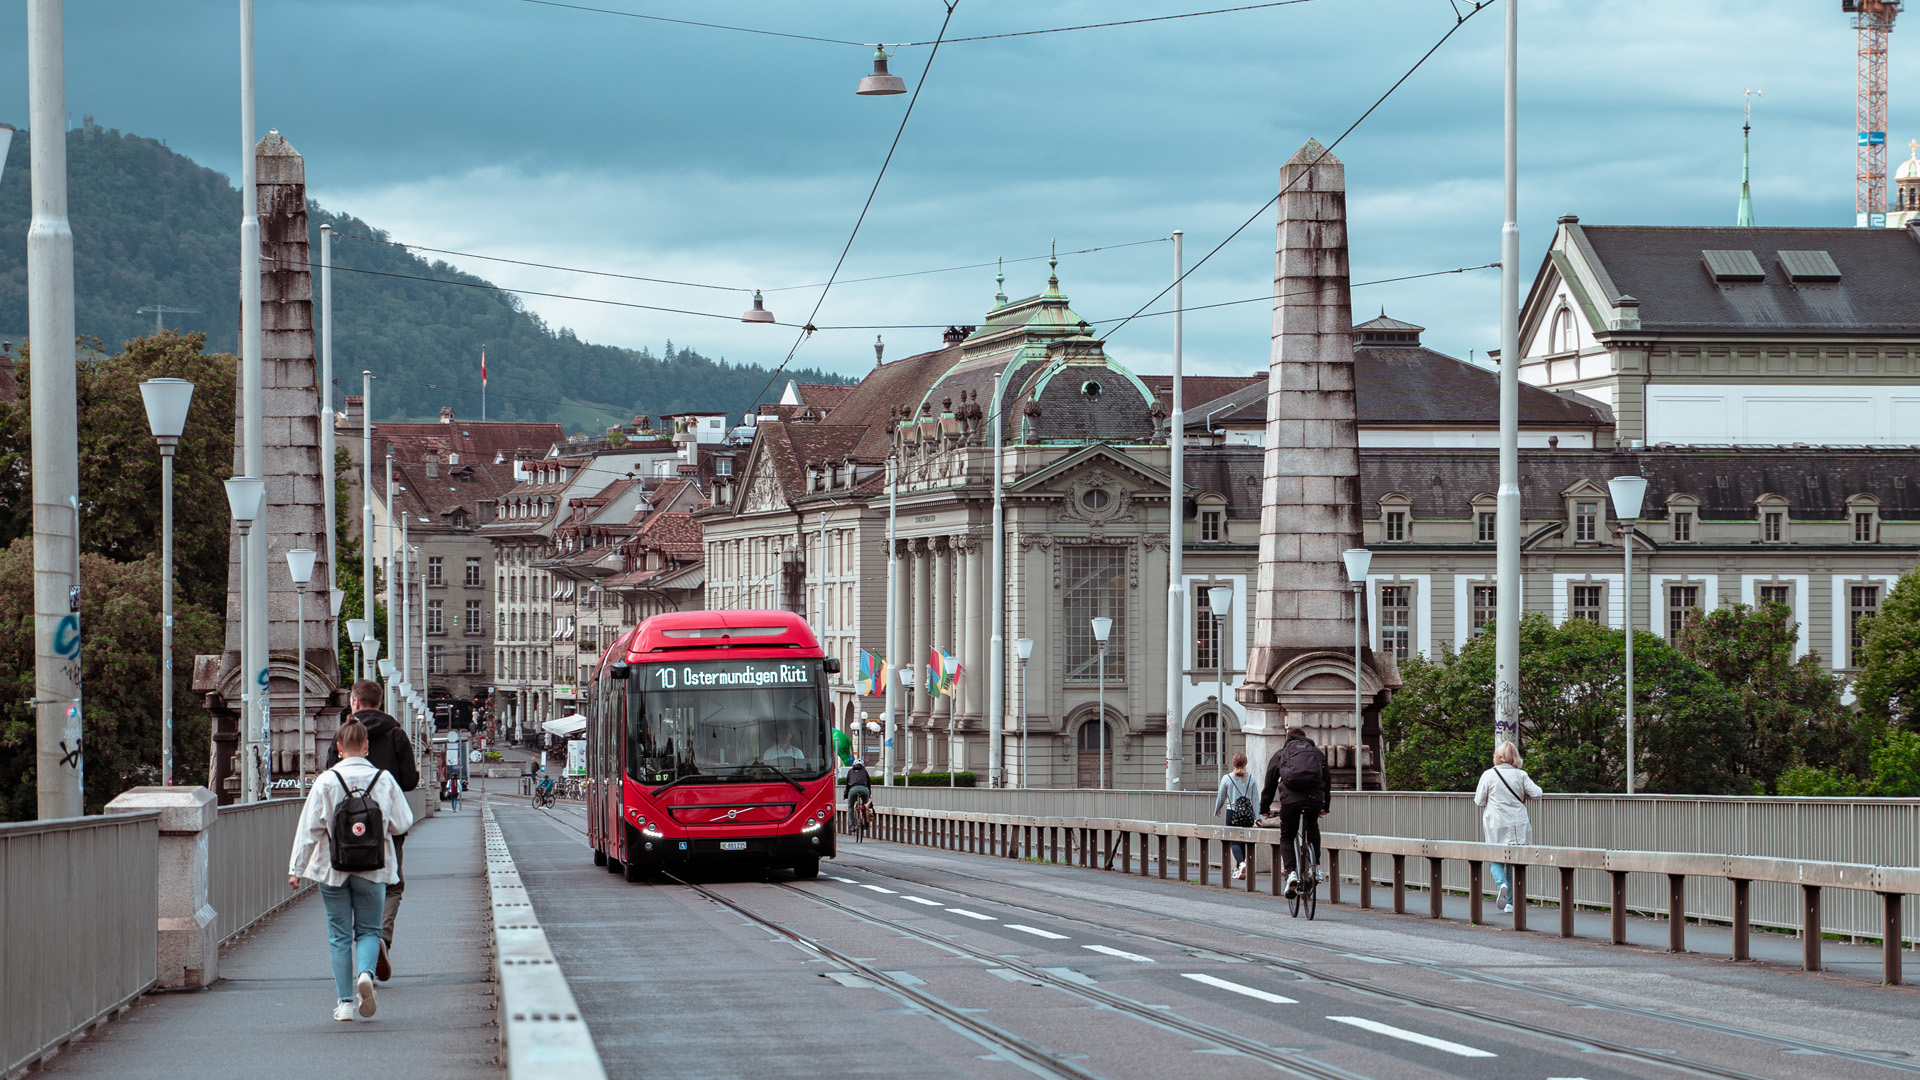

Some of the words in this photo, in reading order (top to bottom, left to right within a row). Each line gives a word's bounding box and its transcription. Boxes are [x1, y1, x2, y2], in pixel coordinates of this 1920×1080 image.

[655, 667, 677, 688] 10
[683, 666, 778, 686] Ostermundigen
[780, 664, 808, 683] Rüti
